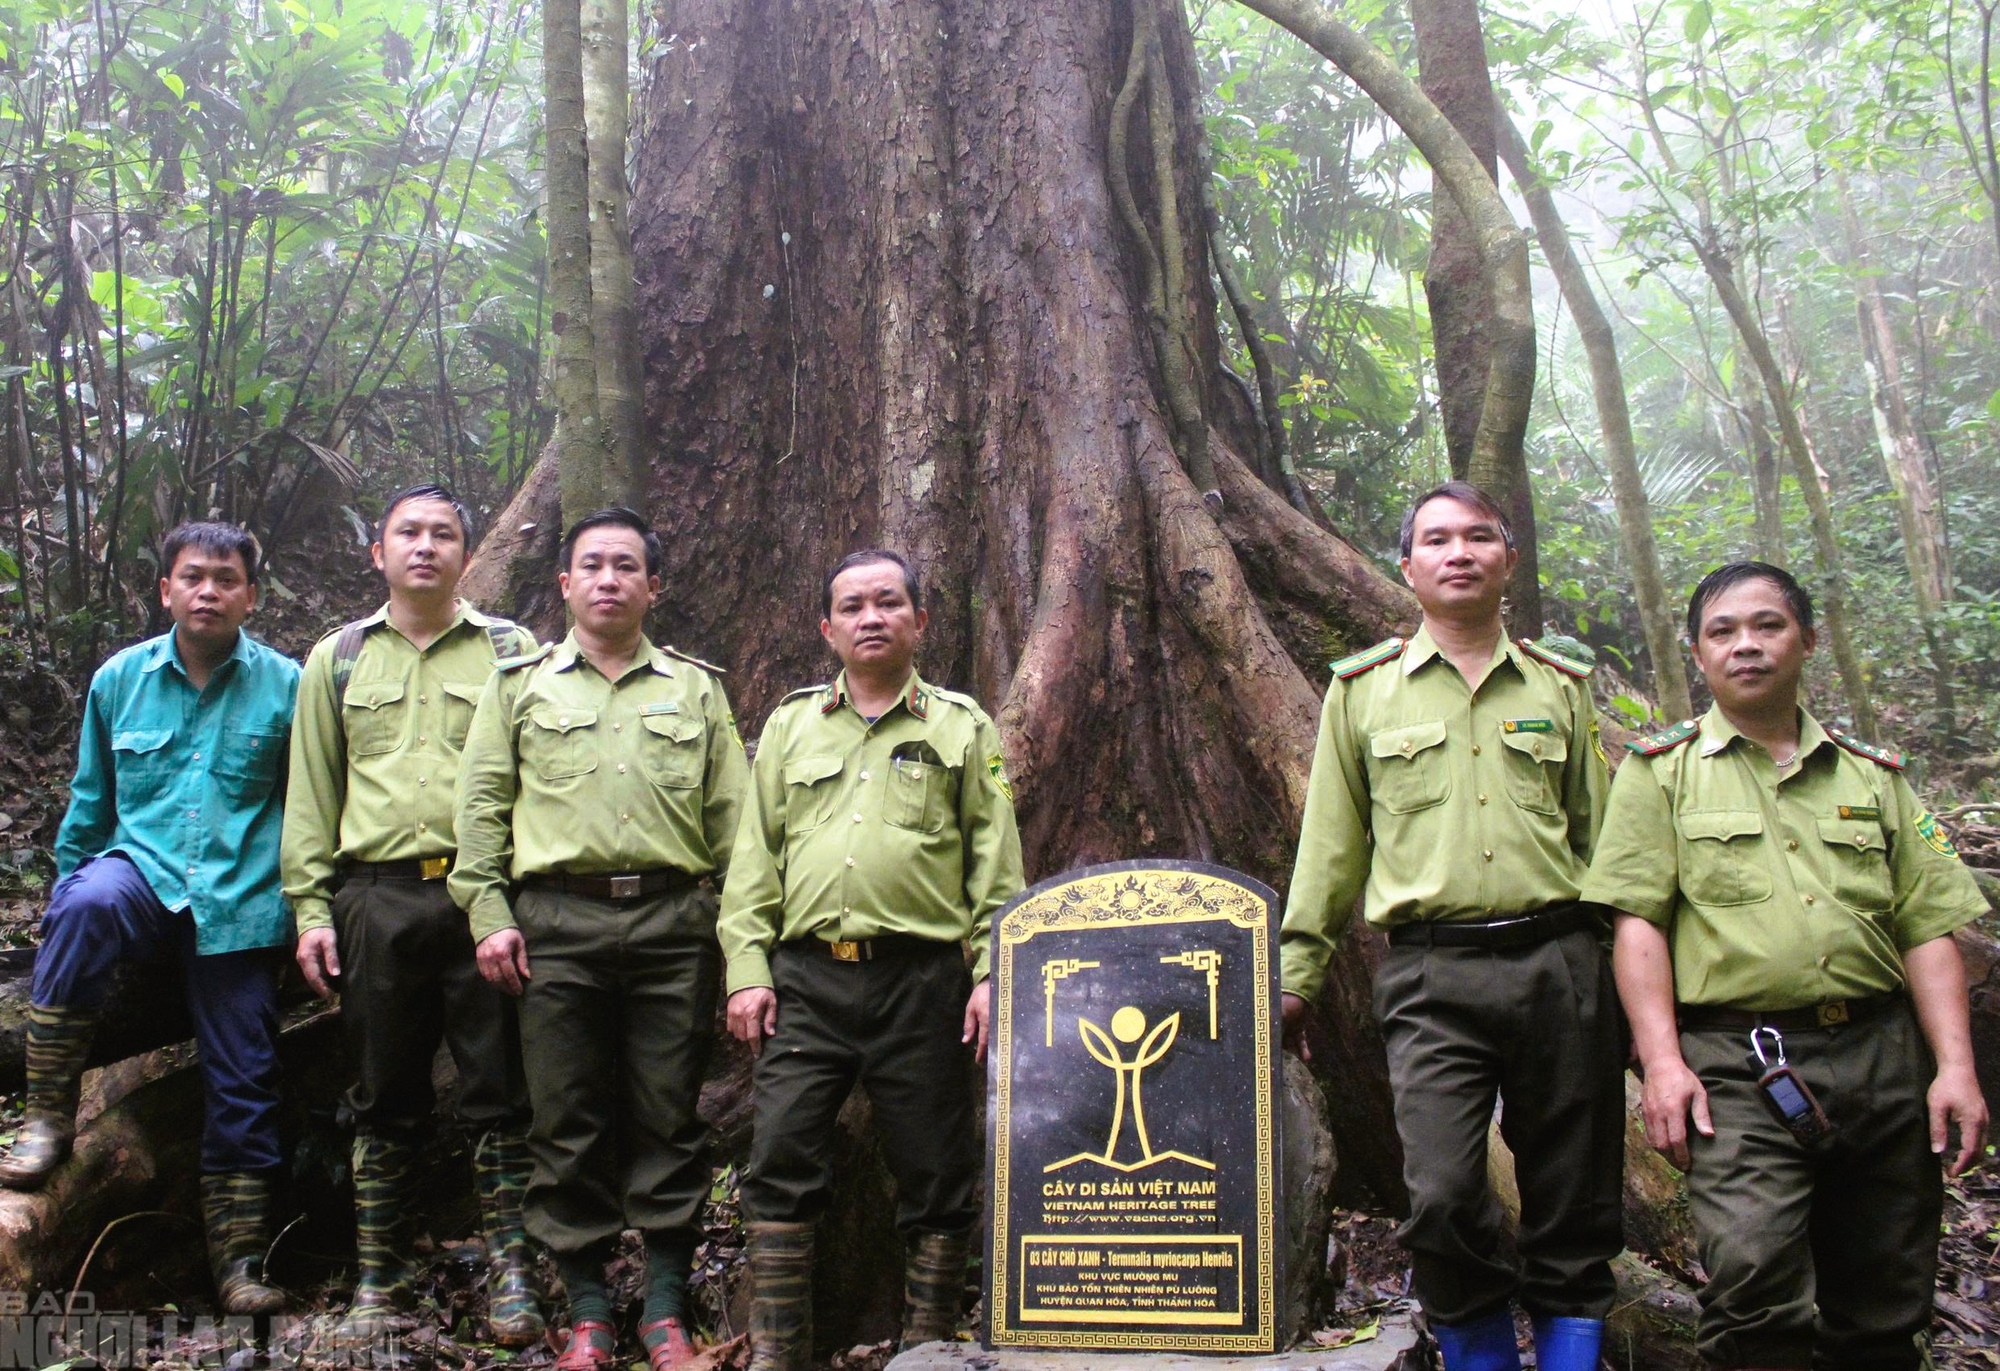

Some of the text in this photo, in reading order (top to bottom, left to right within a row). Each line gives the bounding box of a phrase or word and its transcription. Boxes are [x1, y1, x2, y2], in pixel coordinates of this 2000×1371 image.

[1042, 1177, 1216, 1199] CÂY DI SẢN VIỆT NAM
[1043, 1200, 1216, 1211] VIETNAM HERITAGE TREE
[1078, 1251, 1100, 1266] XANH
[1153, 1251, 1200, 1269] myriocarpa
[1079, 1272, 1098, 1281] KHU
